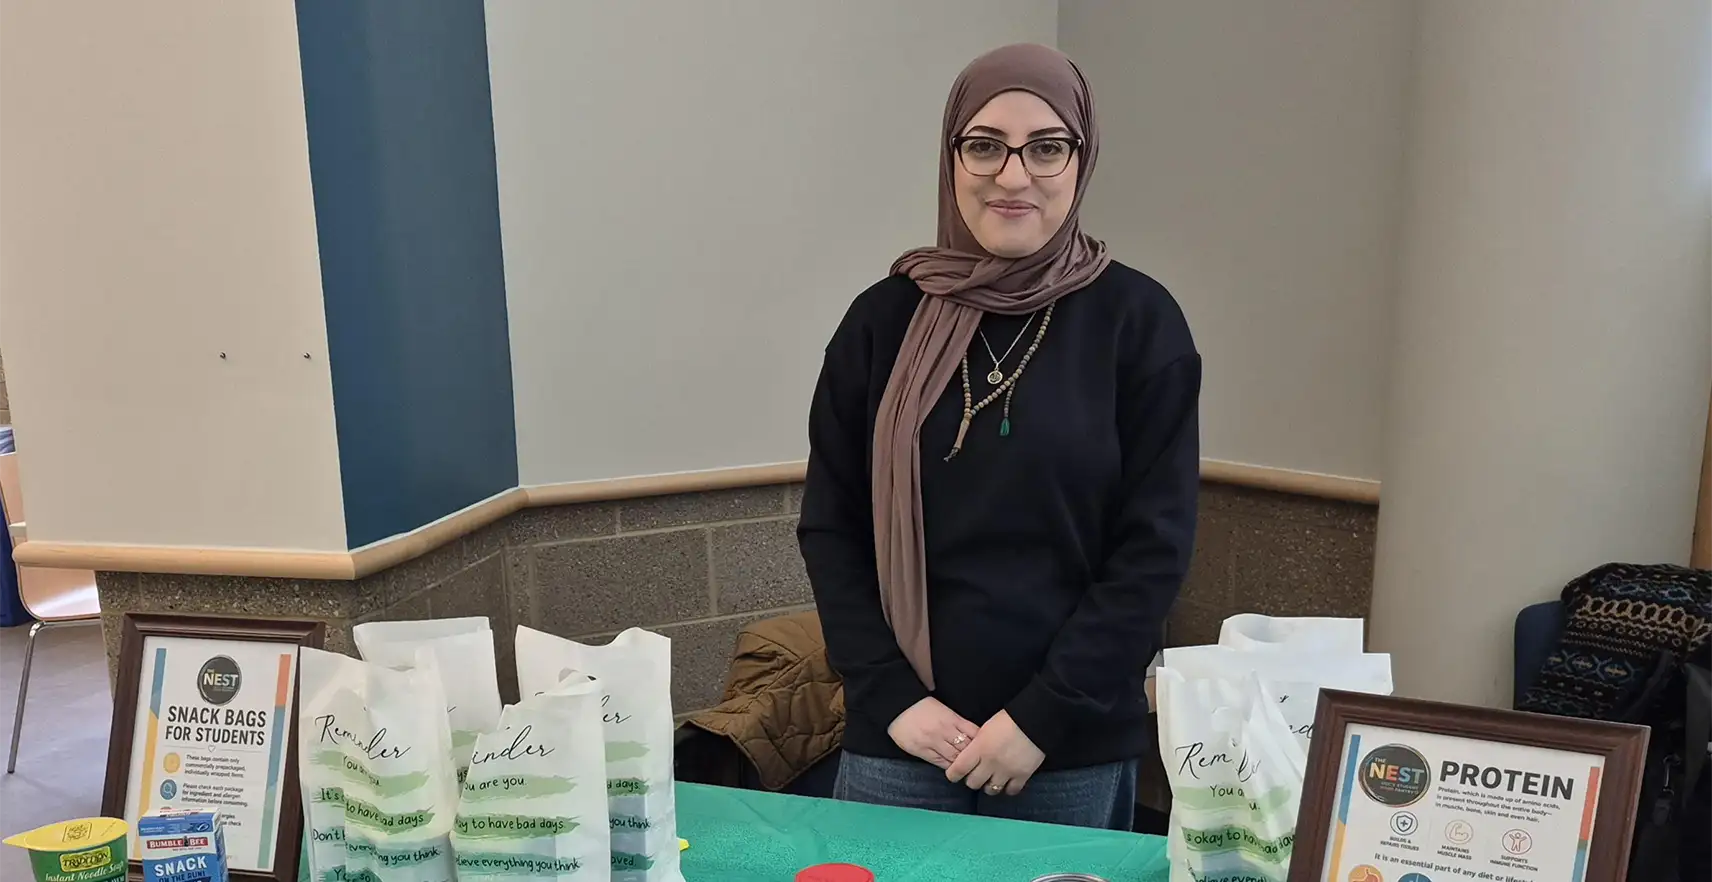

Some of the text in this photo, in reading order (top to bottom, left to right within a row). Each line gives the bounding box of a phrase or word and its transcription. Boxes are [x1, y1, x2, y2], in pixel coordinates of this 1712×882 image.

[203, 672, 239, 687] NEST
[168, 705, 267, 728] SNACK BAGS
[165, 725, 265, 746] FOR STUDENTS
[472, 724, 555, 765] inder
[1369, 762, 1424, 784] NEST
[1439, 760, 1575, 801] PROTEIN
[479, 779, 498, 791] are
[1209, 784, 1233, 797] You
[189, 790, 212, 798] ingredient
[1438, 786, 1460, 795] Protein,
[1462, 790, 1480, 798] which
[1522, 799, 1542, 807] amino
[1542, 802, 1561, 810] acids,
[1442, 795, 1465, 804] present
[1466, 797, 1500, 809] throughout
[1512, 805, 1530, 814] entire
[346, 800, 356, 813] to
[381, 814, 394, 827] ad
[1442, 803, 1464, 812] muscle,
[1510, 813, 1525, 821] even
[1526, 815, 1540, 823] hair.
[472, 818, 485, 829] to
[488, 816, 513, 829] have
[516, 817, 536, 829] bad
[608, 818, 626, 830] you
[312, 828, 341, 841] Don't
[1194, 831, 1223, 847] okay
[1226, 829, 1241, 841] to
[149, 837, 206, 848] BUMBLE BEE
[1441, 844, 1470, 854] MAINTAINS
[390, 852, 411, 865] you
[413, 846, 441, 861] think
[611, 855, 637, 866] oved.
[1500, 854, 1528, 864] SUPPORTS
[154, 856, 207, 877] SNACK
[481, 857, 534, 871] everything
[534, 860, 552, 873] you
[553, 857, 581, 871] think
[1400, 857, 1434, 869] essential
[1434, 863, 1451, 872] part
[1452, 866, 1461, 874] of
[1462, 870, 1477, 879] any
[1477, 871, 1494, 880] diet
[1489, 859, 1539, 872] IMMUNE FUNCTION
[45, 873, 75, 882] Instant
[76, 869, 107, 880] Noodle
[171, 873, 186, 881] THE
[188, 871, 206, 879] RUN!
